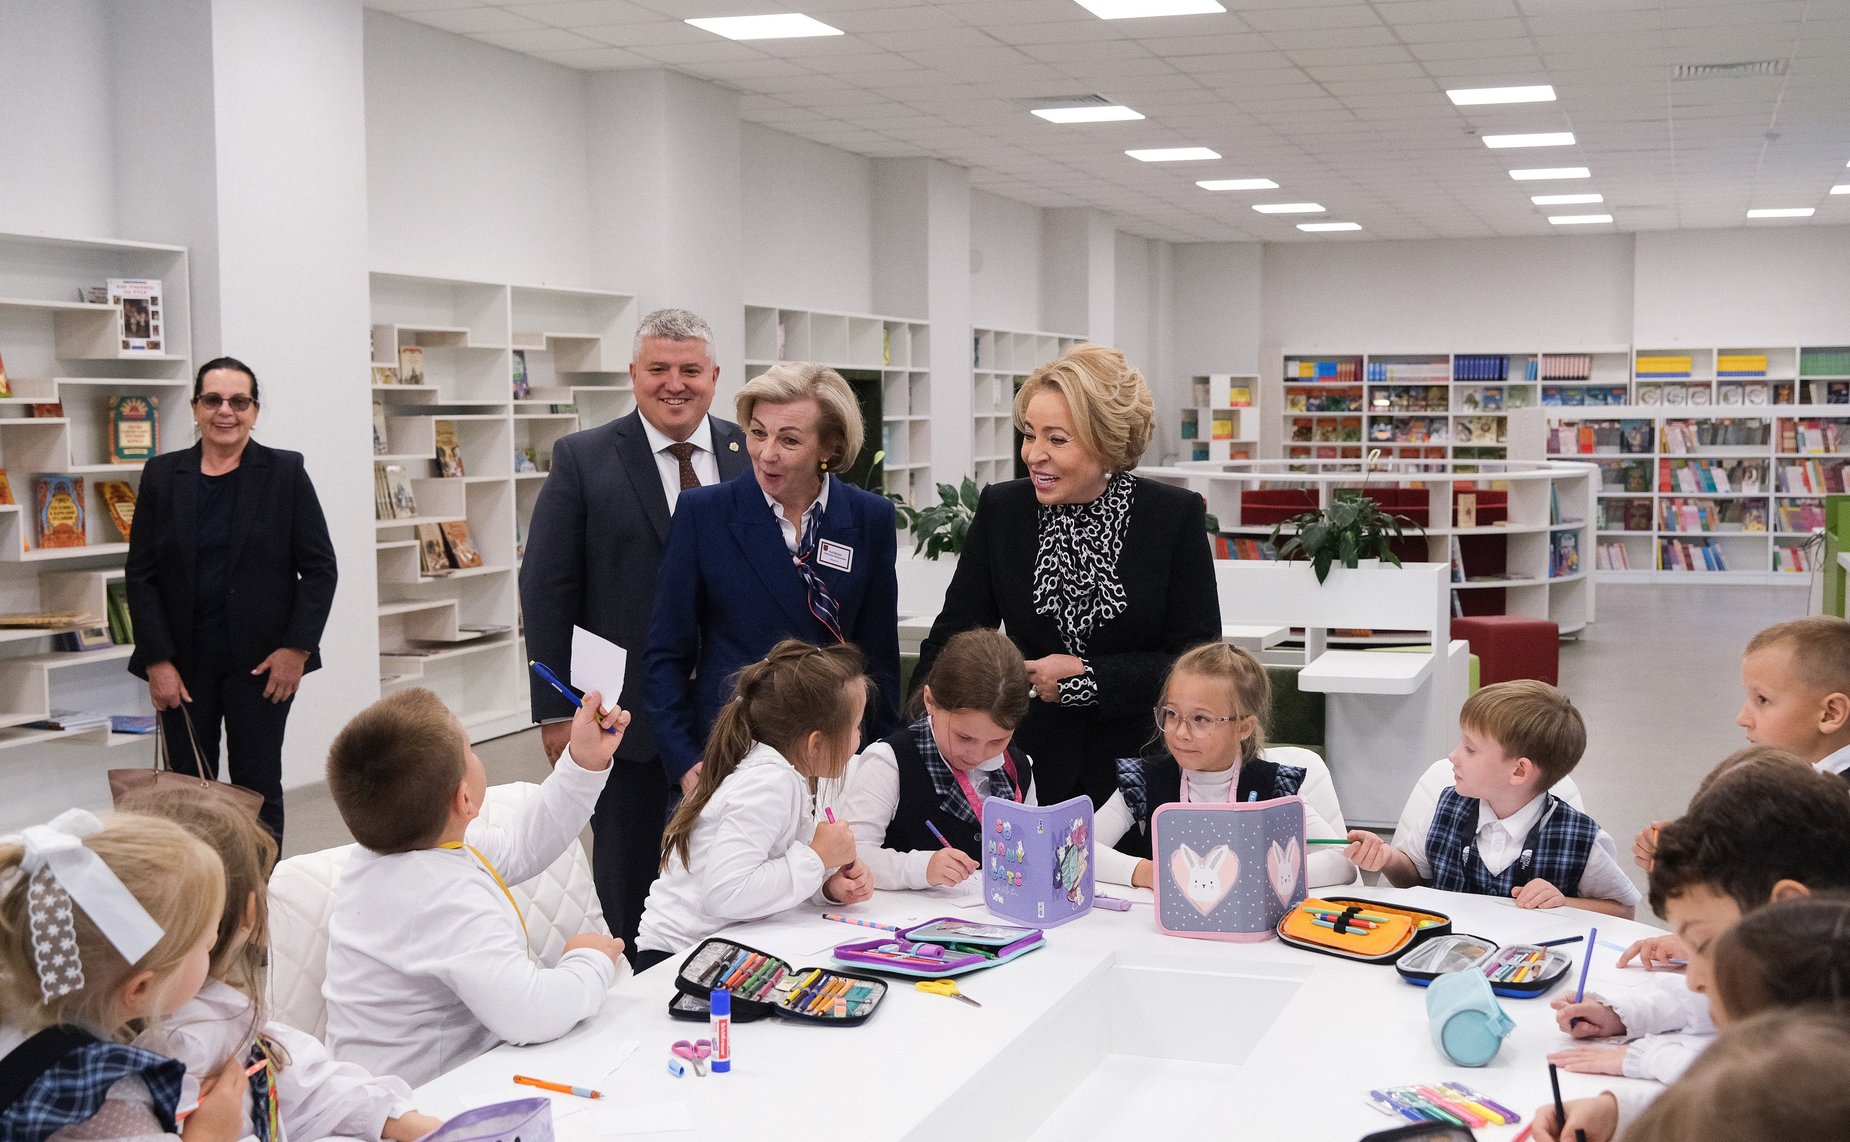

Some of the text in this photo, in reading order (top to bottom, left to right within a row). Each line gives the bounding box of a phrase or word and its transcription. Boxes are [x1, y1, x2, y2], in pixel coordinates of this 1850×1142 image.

[996, 818, 1012, 841] SO
[988, 840, 1025, 865] MANY
[990, 865, 1023, 887] CATS
